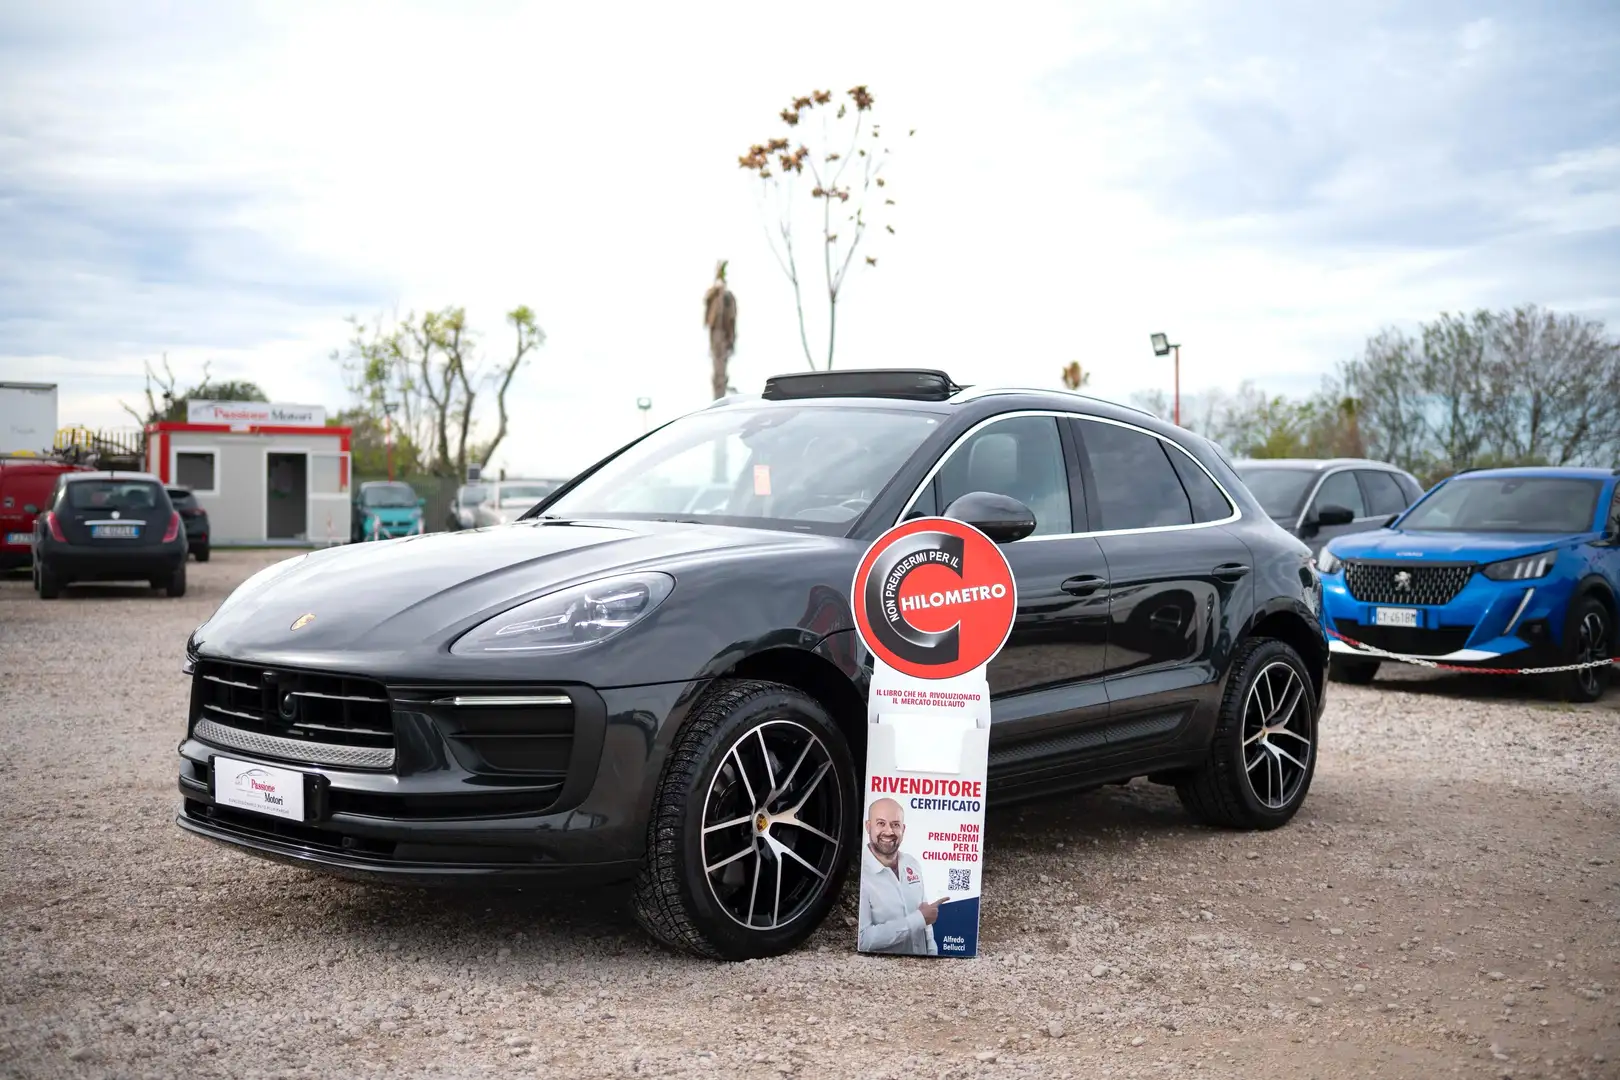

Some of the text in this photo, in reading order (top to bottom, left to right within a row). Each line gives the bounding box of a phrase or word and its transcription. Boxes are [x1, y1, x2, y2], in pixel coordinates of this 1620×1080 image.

[885, 551, 959, 622] NON PRENDERMI PER IL
[883, 689, 902, 697] LIBRO
[903, 690, 916, 698] CHE
[929, 691, 981, 701] RIVOLUZIONATO
[901, 698, 931, 706] MERCATO
[932, 699, 965, 708] DELL'AUTO
[251, 778, 275, 792] Passione
[871, 776, 981, 797] RIVENDITORE
[264, 792, 284, 806] Motori
[910, 797, 980, 812] CERTIFICATO
[960, 824, 980, 833] NON
[928, 832, 979, 842] PRENDERMI
[953, 843, 979, 852] PER IL
[922, 851, 978, 862] CHILOMETRO
[943, 936, 965, 944] Alfredo
